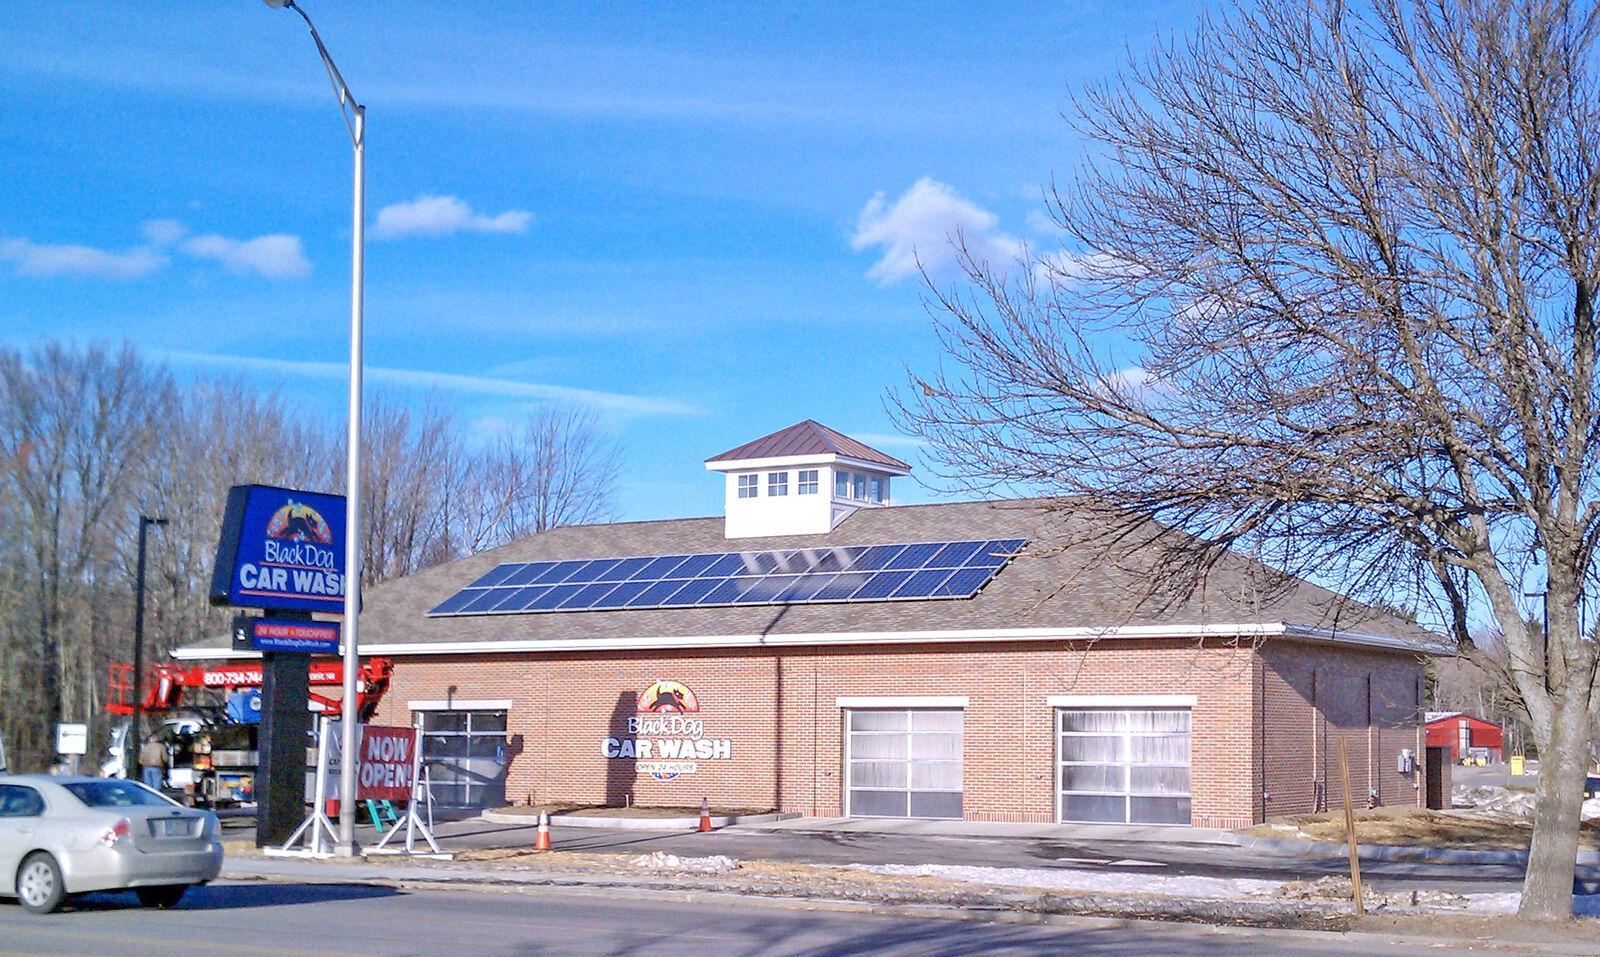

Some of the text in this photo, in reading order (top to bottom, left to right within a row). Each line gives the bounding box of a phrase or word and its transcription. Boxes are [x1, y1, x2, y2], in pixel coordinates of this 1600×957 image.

[265, 540, 335, 574] Black Dog
[240, 563, 288, 592] CAR
[628, 715, 704, 740] Black Dog
[367, 735, 409, 762] NOW
[601, 737, 732, 759] CAR WASH
[361, 763, 412, 788] OPEN!
[636, 763, 694, 772] OPEN 24 HOURS
